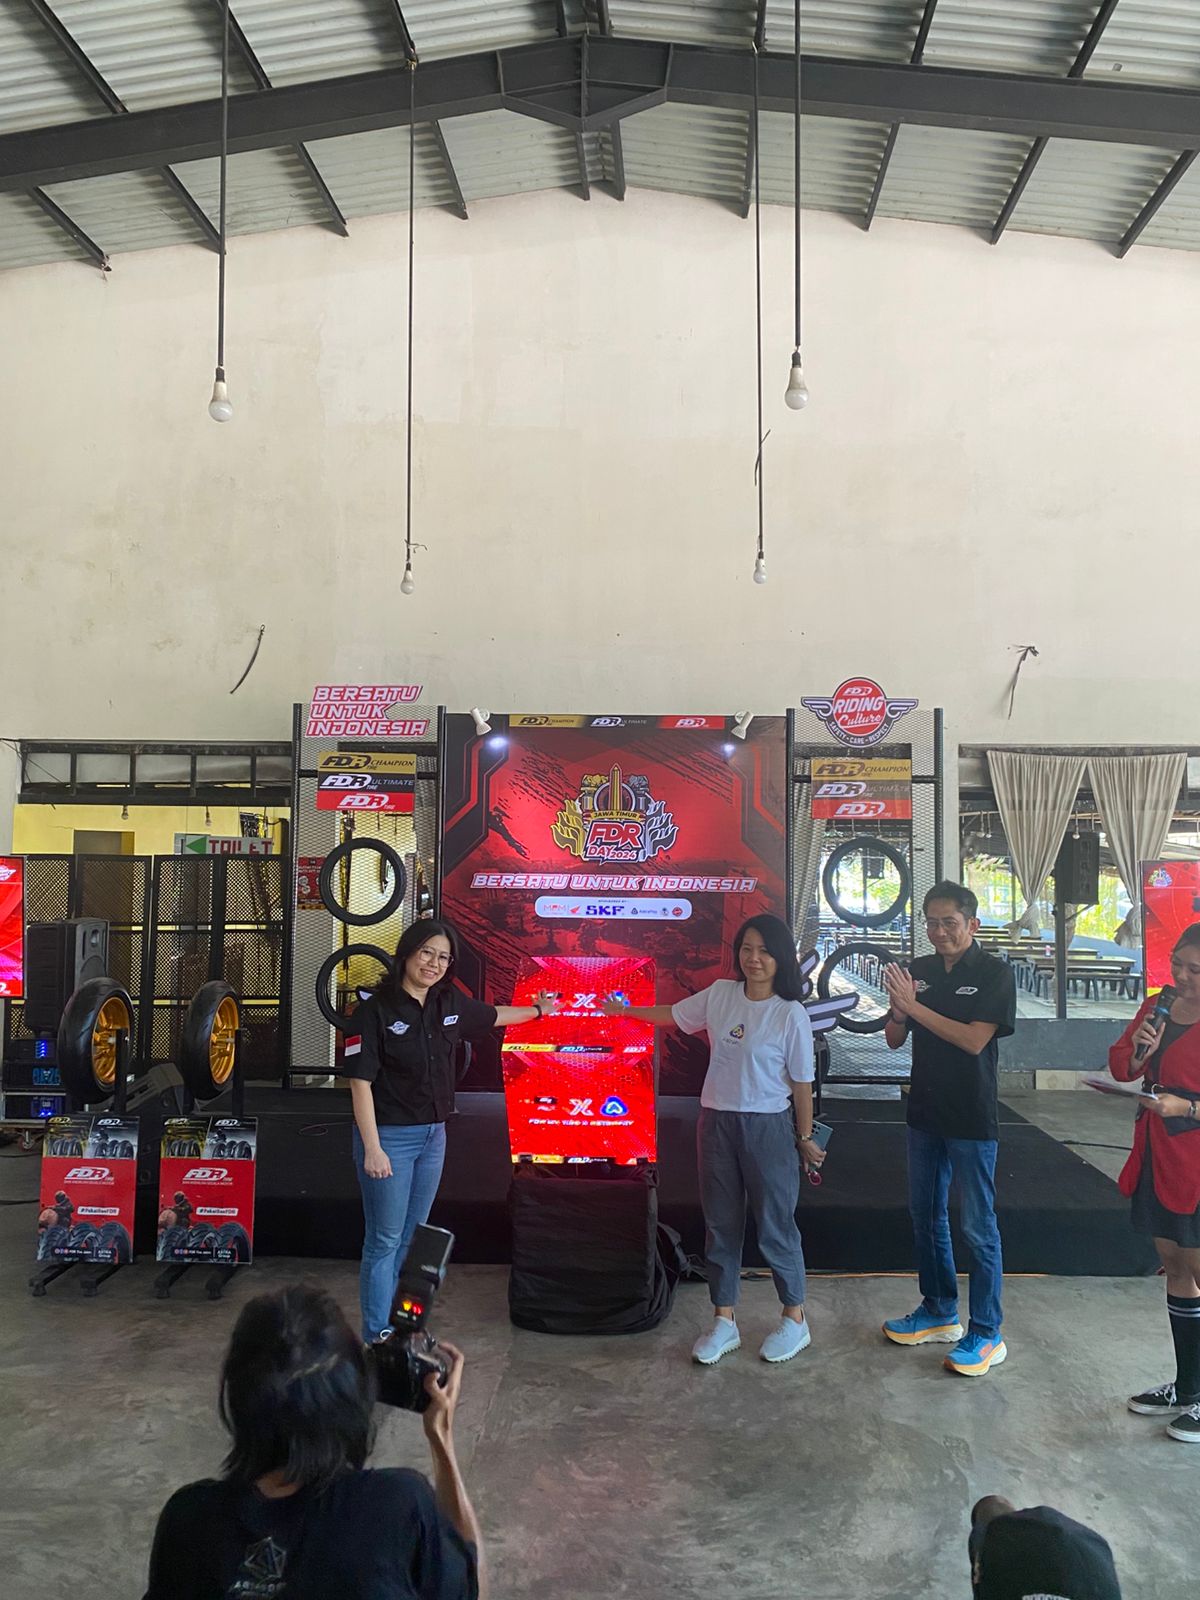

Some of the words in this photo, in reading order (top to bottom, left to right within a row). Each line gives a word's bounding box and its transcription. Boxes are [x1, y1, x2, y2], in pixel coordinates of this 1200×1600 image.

[313, 686, 421, 702] BERSATU
[310, 703, 388, 719] UNTUK
[834, 696, 886, 714] RIDING
[518, 716, 549, 726] FDR
[590, 717, 621, 727] FDR
[674, 717, 706, 728] FDR
[839, 712, 882, 727] Culture
[306, 720, 429, 736] INDONESIA
[829, 721, 847, 740] SAFETY
[868, 723, 889, 743] RESPECT
[320, 754, 372, 769] FDR
[813, 762, 866, 777] FDR
[320, 774, 372, 789] FDR
[371, 778, 415, 786] ULTIMATE
[814, 782, 866, 797] FDR
[337, 793, 389, 809] FDR
[833, 801, 886, 817] FDR
[589, 822, 641, 848] FDR
[588, 846, 614, 857] DAY
[611, 851, 637, 859] 2024
[471, 873, 568, 890] BERSATU
[570, 875, 643, 890] UNTUK
[643, 876, 758, 892] INDONESIA
[586, 905, 625, 916] SKF
[97, 1118, 121, 1126] FDR
[214, 1118, 239, 1127] FDR
[64, 1166, 110, 1180] FDR
[182, 1167, 228, 1181] FDR
